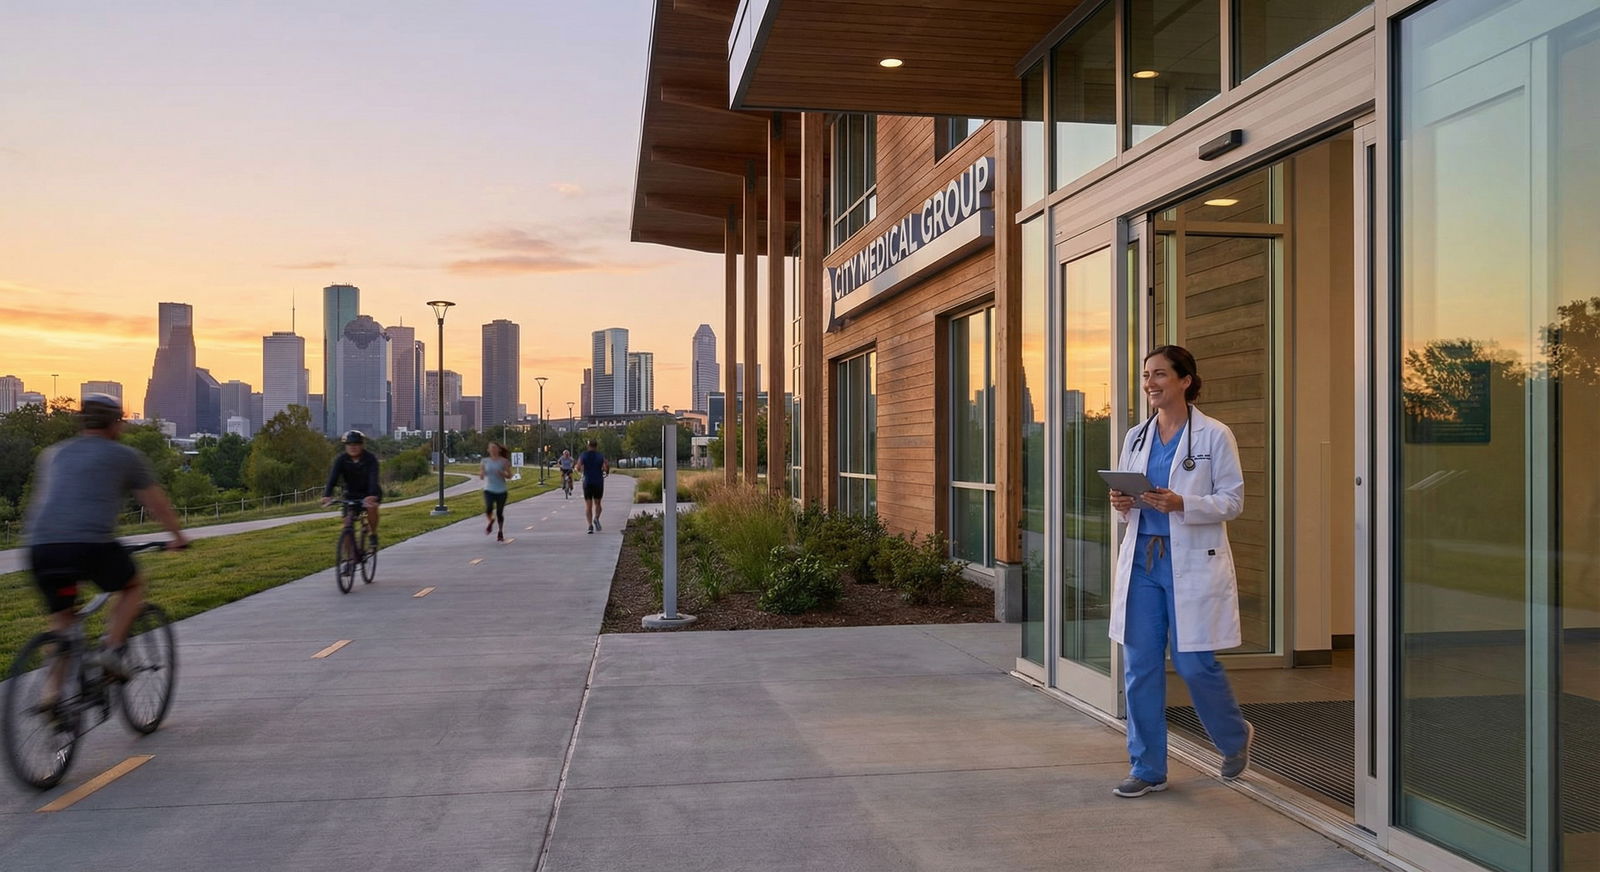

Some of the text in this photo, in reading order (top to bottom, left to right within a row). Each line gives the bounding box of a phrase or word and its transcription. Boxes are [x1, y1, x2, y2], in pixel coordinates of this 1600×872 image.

[835, 156, 989, 300] CITY MEDICAL GROUP
